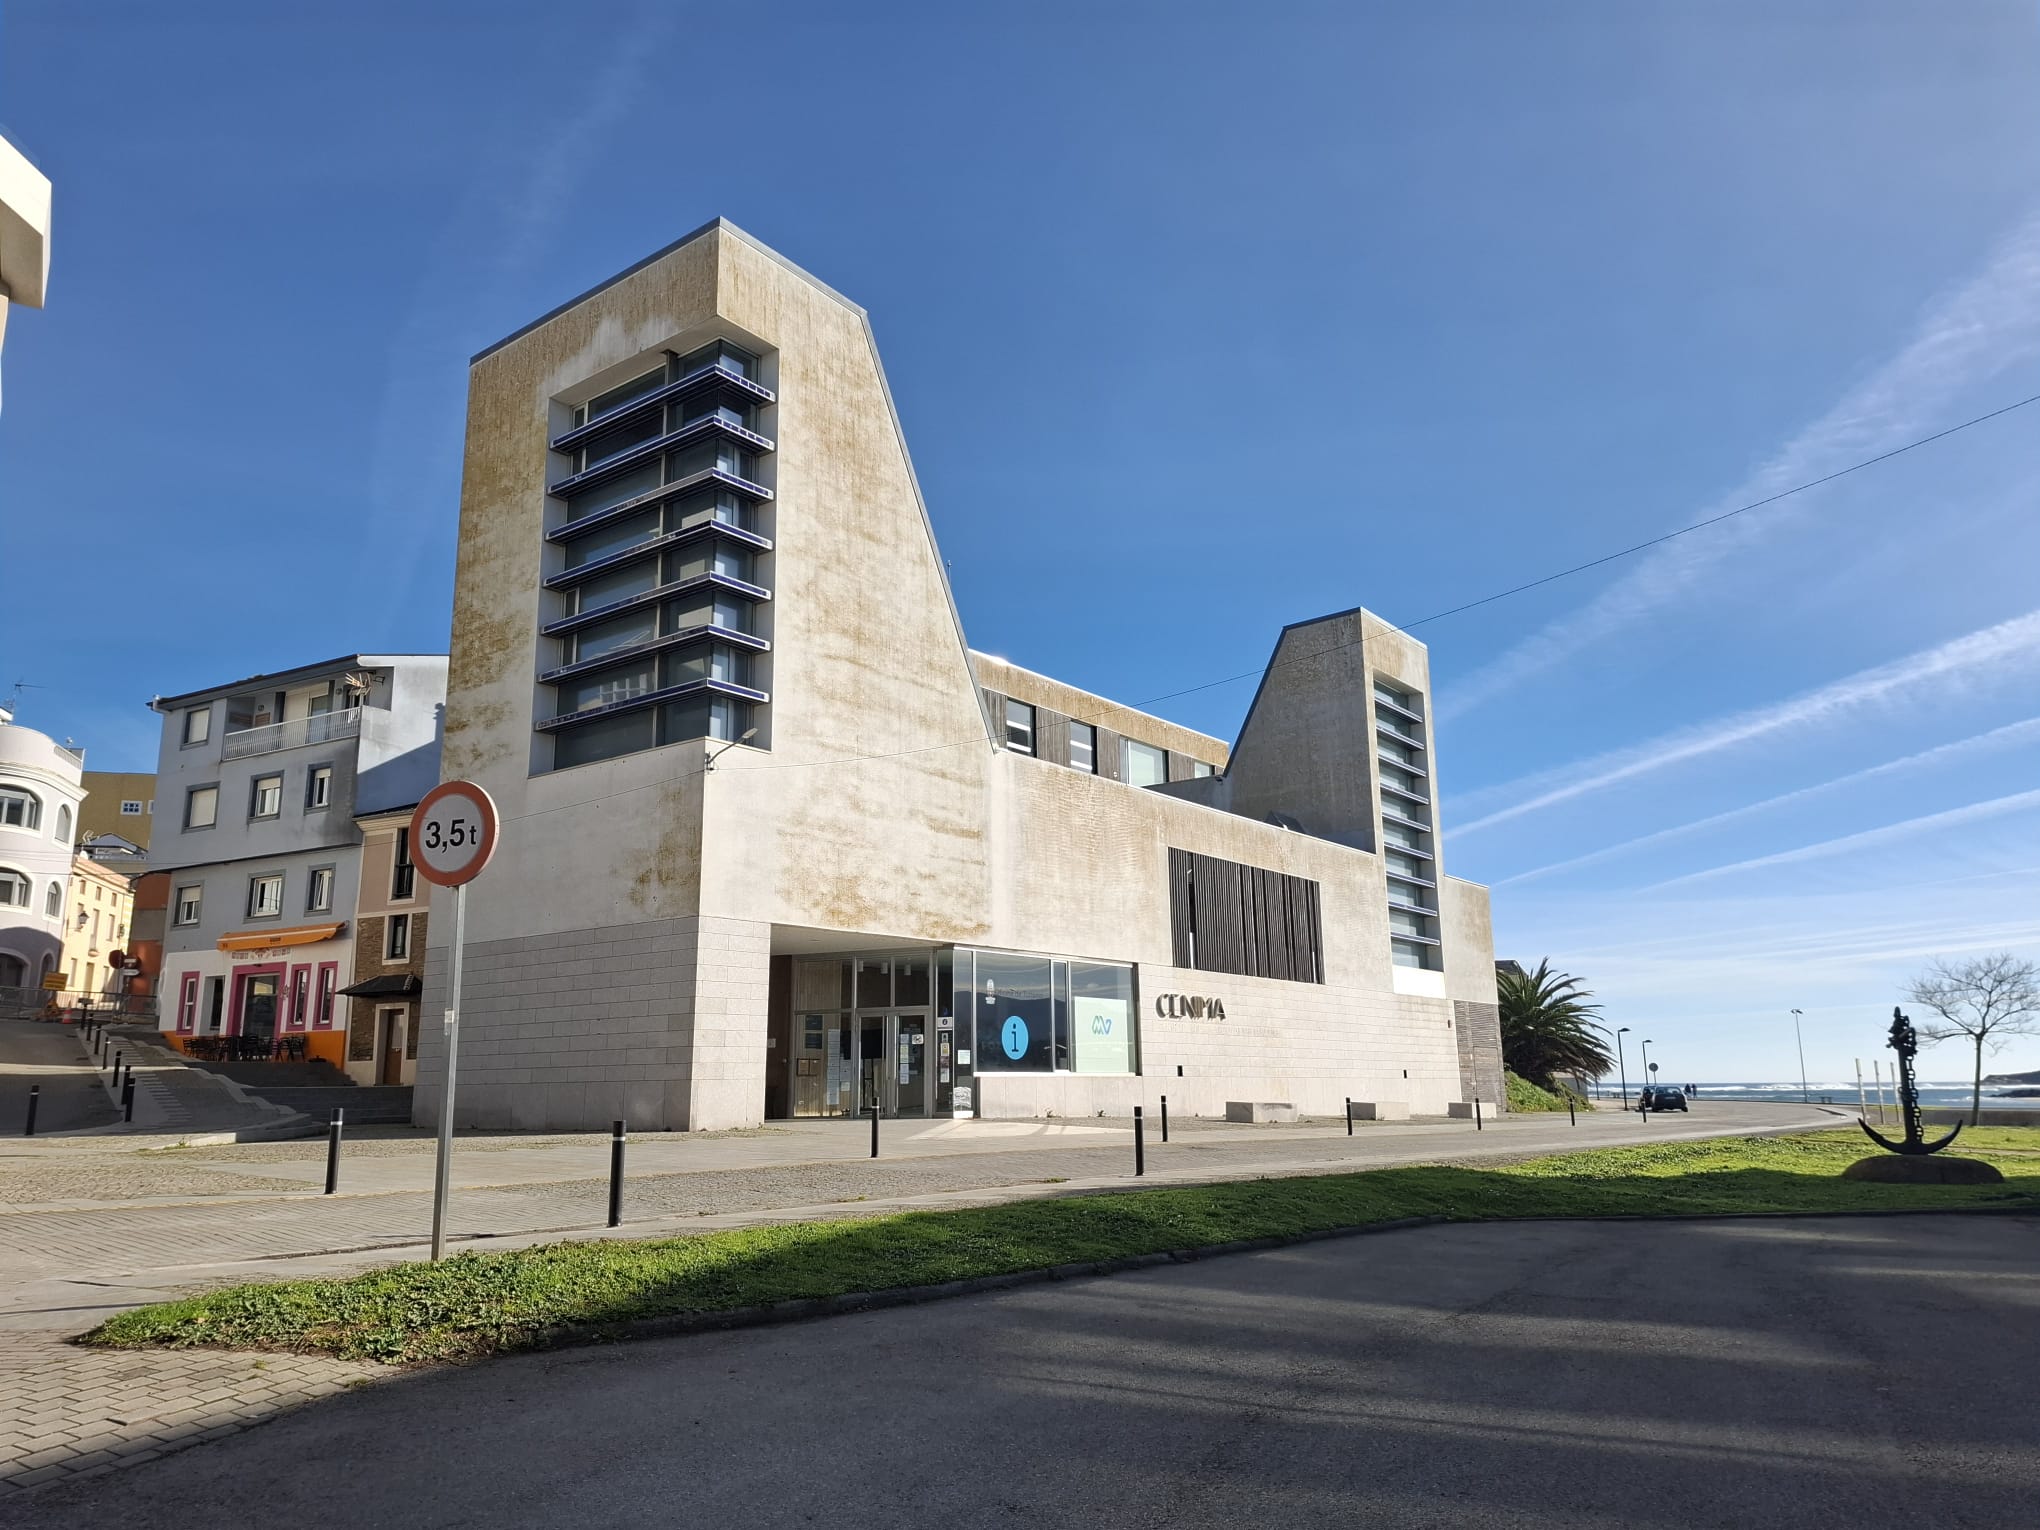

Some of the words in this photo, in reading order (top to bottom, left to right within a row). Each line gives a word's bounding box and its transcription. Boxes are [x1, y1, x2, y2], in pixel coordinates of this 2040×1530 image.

[425, 818, 465, 853] 3,5
[469, 825, 477, 845] t
[1155, 993, 1226, 1021] CENIMA
